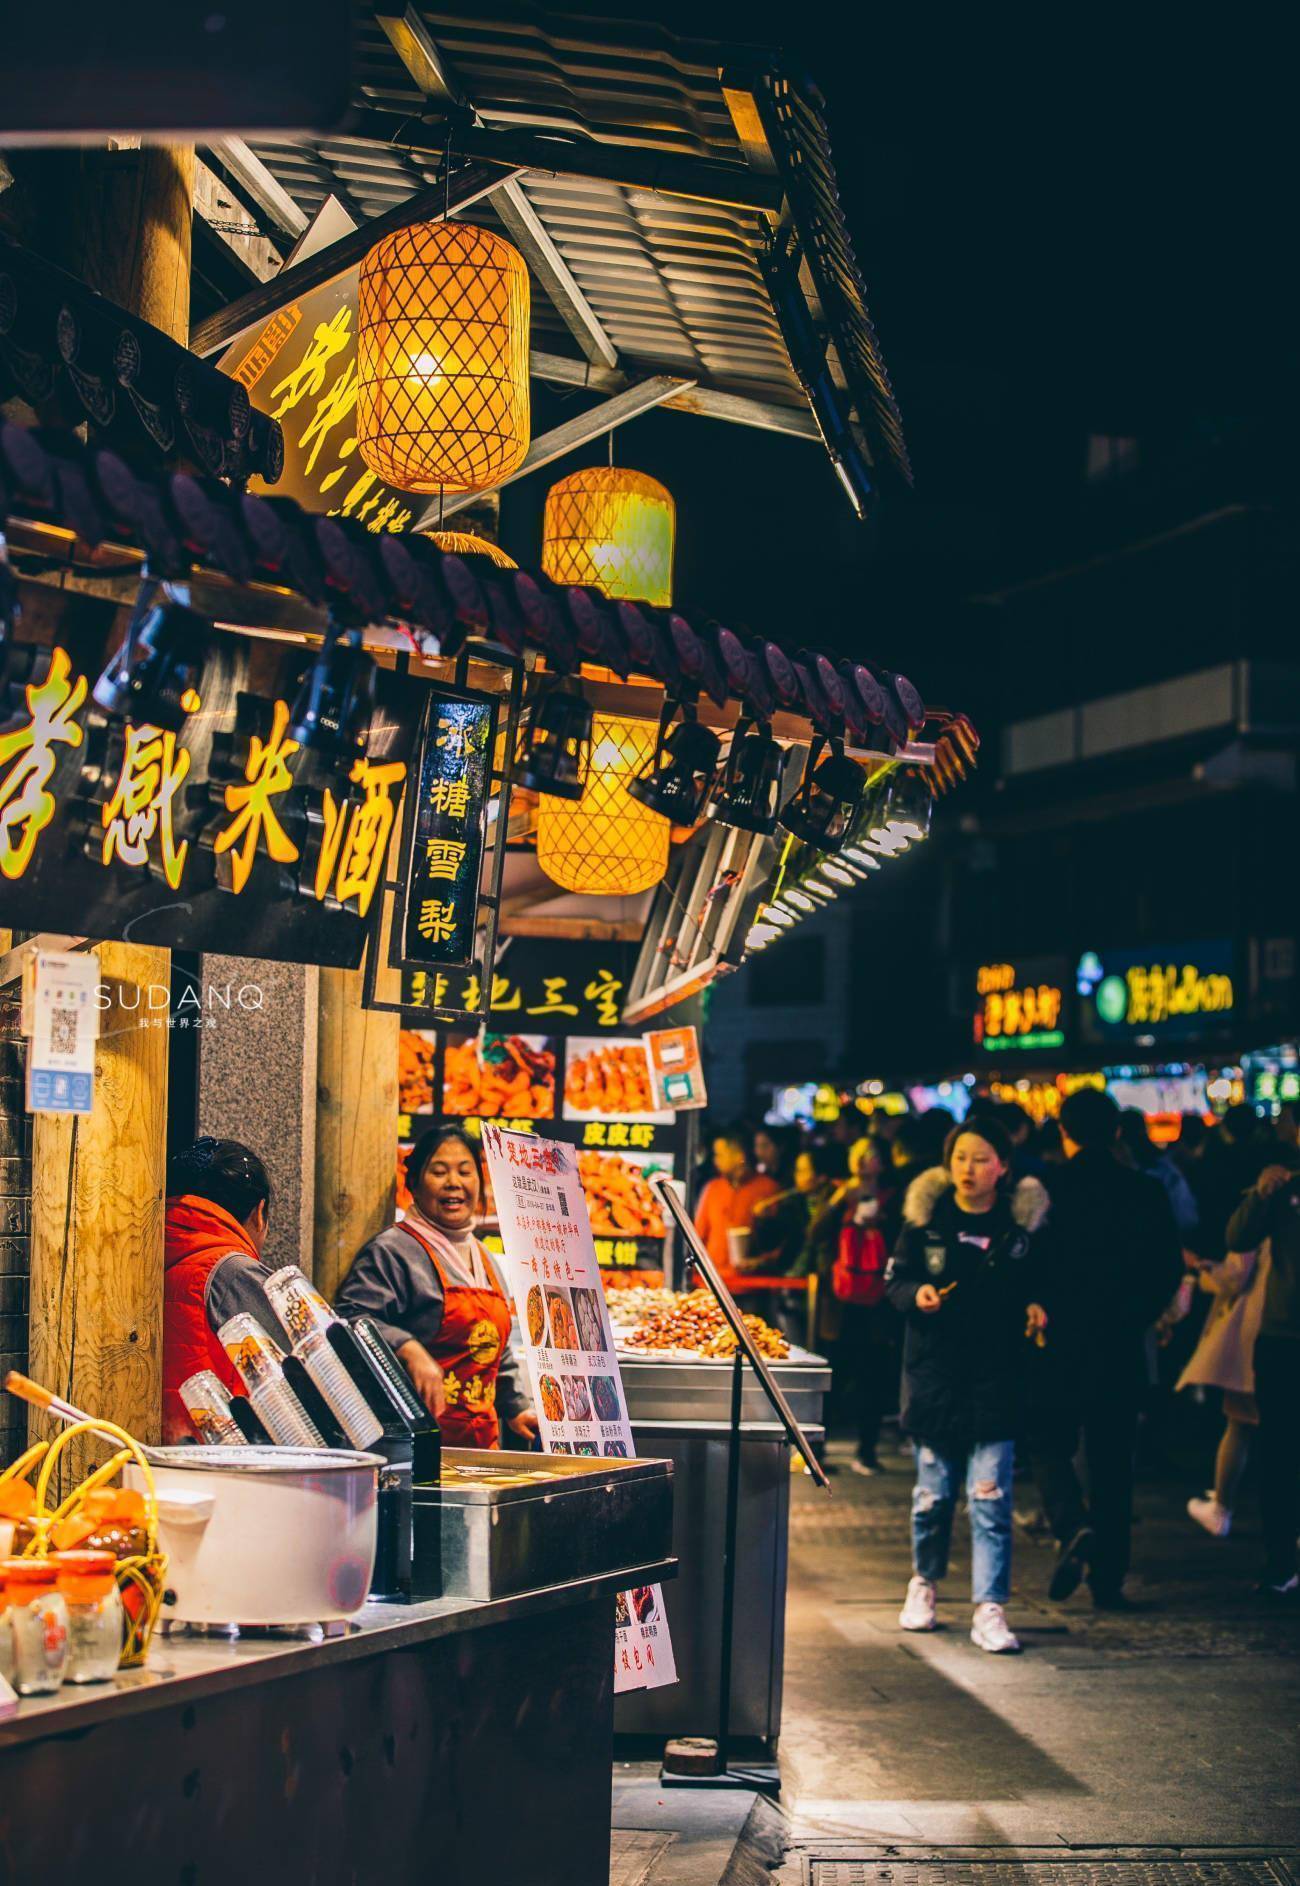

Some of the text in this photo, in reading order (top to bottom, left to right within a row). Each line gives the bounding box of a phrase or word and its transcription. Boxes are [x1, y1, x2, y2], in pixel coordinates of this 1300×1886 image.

[418, 718, 476, 943] 冰糖雪梨
[582, 1122, 655, 1148] 皮皮虾
